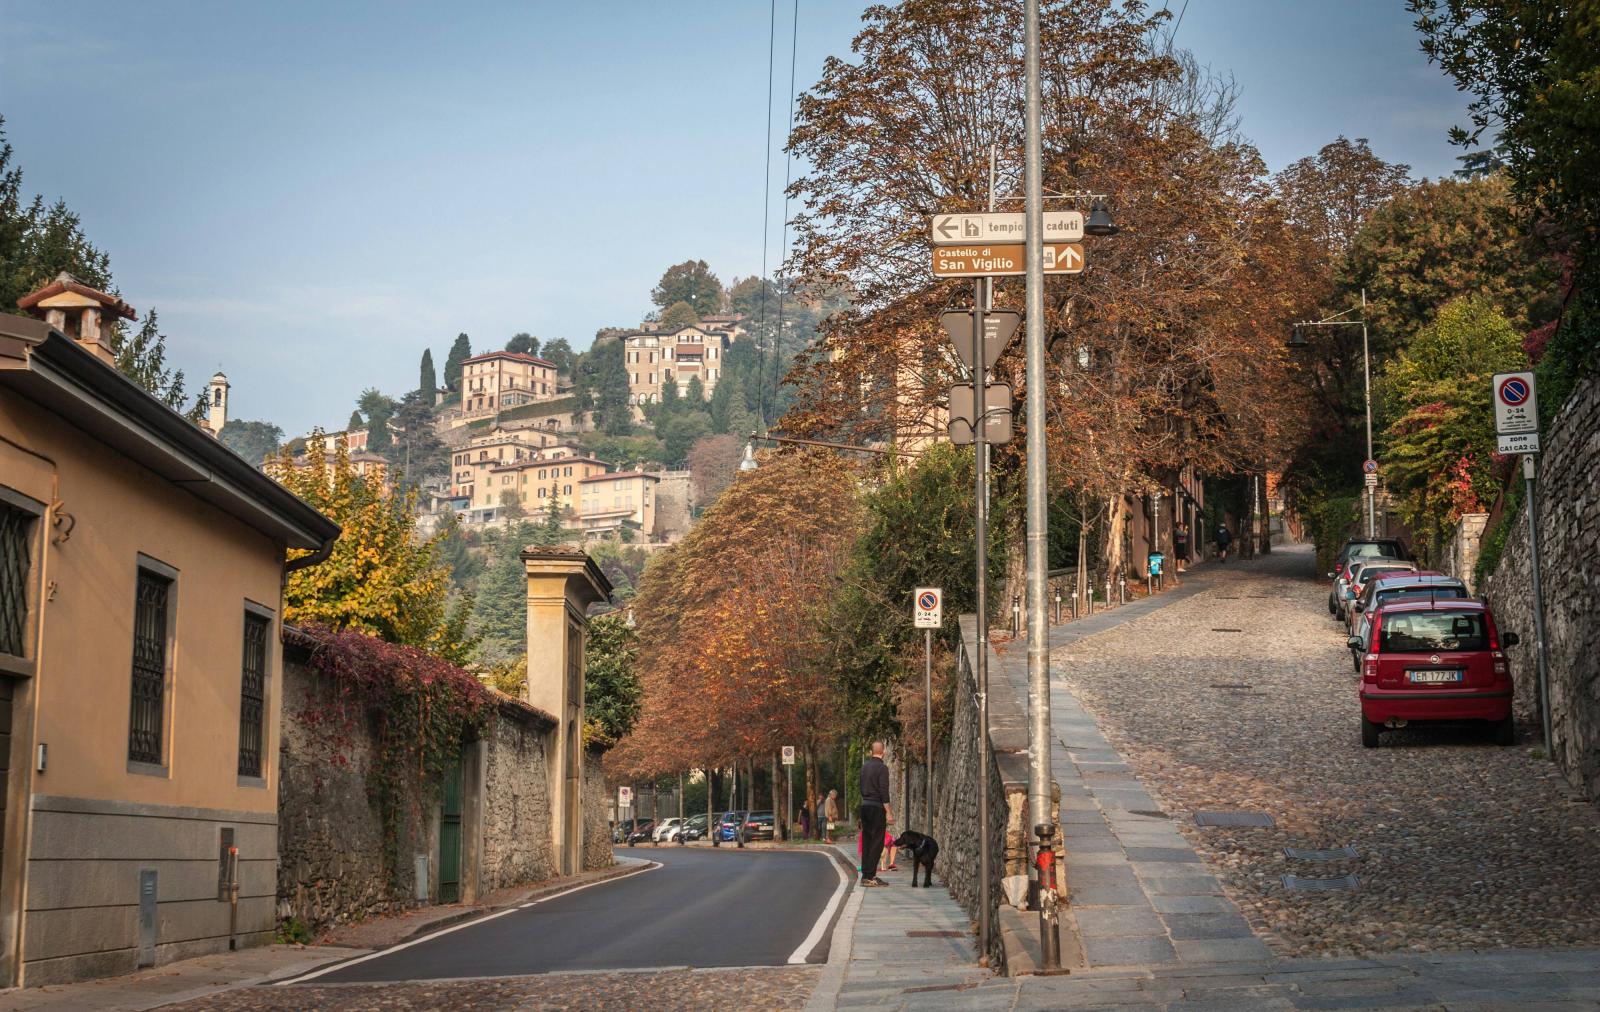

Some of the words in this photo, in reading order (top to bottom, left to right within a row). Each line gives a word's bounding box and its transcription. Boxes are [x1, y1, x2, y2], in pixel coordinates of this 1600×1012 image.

[989, 222, 1024, 234] tempio
[1046, 220, 1078, 231] caduti
[938, 248, 978, 257] Castello
[982, 248, 991, 257] di
[939, 259, 965, 270] San
[972, 257, 1014, 271] Vigilio
